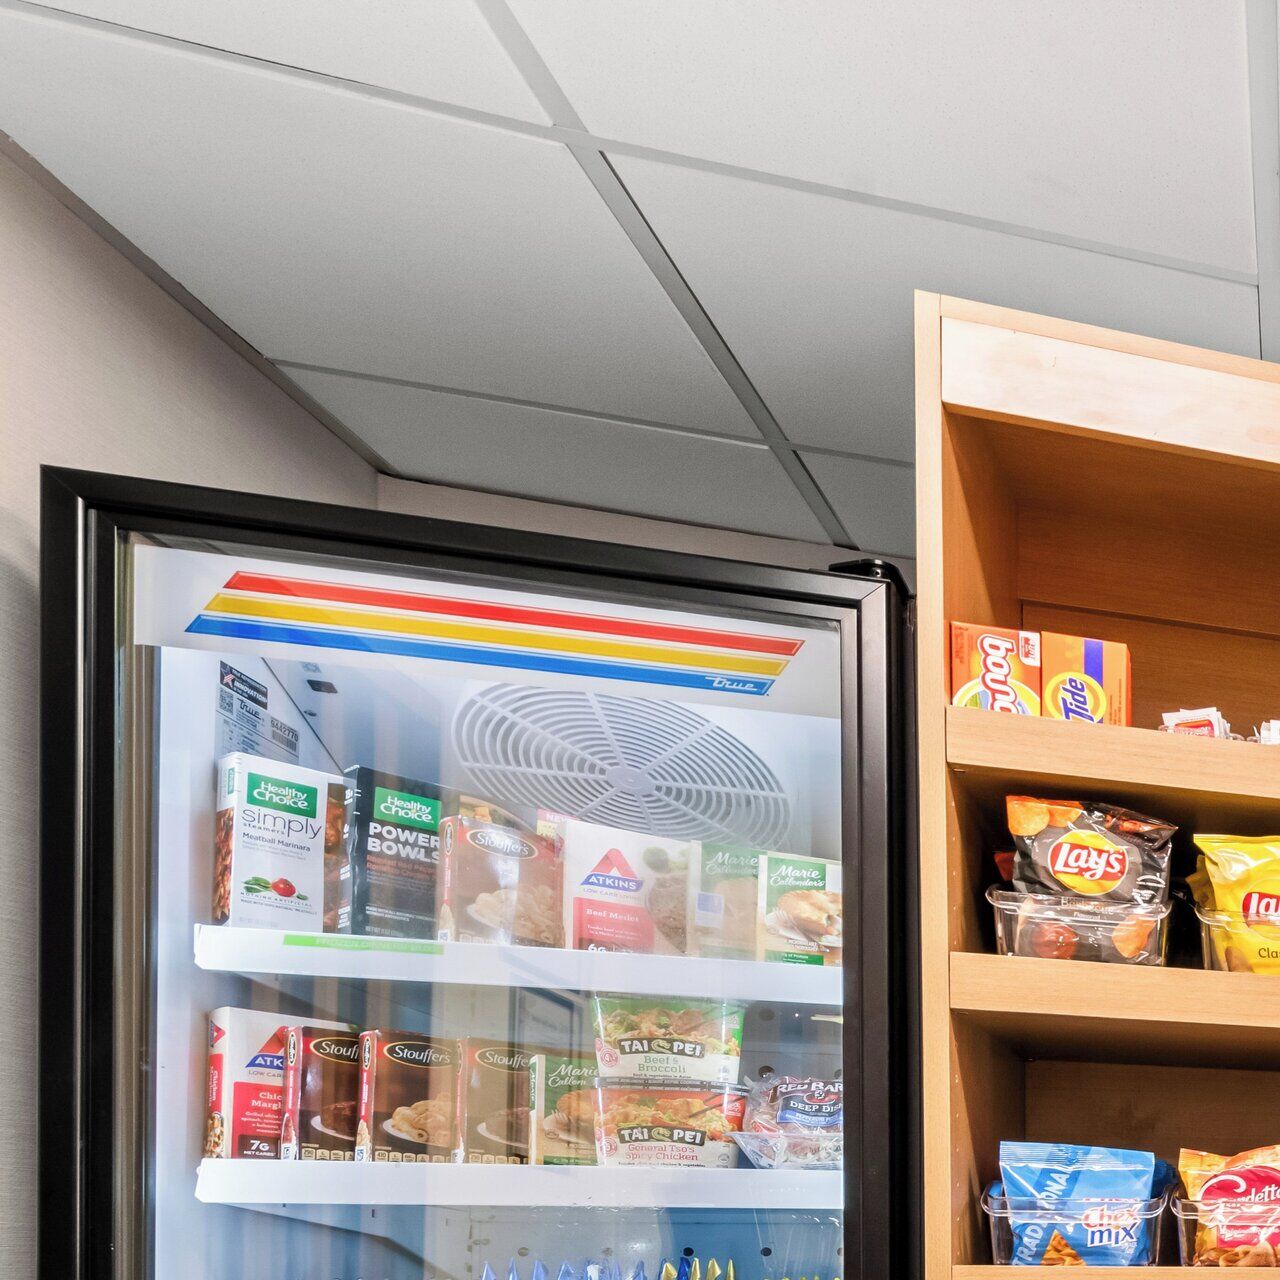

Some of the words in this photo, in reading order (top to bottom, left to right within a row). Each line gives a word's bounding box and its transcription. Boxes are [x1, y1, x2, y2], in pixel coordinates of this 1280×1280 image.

[1061, 677, 1094, 722] Tide
[261, 781, 307, 800] Healthy
[253, 788, 308, 809] Choice
[387, 796, 431, 814] Healthy
[380, 805, 433, 822] Choice
[241, 808, 321, 839] simply
[243, 823, 285, 835] steamers
[242, 833, 275, 845] Meatball
[278, 837, 311, 852] Marinara
[476, 831, 529, 855] Stouffer's
[1054, 843, 1123, 880] Lay's
[771, 865, 821, 878] Marie
[588, 874, 637, 890] ATKINS
[770, 875, 825, 887] Callender's
[586, 908, 608, 917] Beef
[395, 1045, 450, 1063] Stouffer's
[621, 1041, 648, 1053] TAI
[673, 1041, 704, 1056] PEI
[643, 1055, 669, 1066] Beef
[638, 1063, 686, 1075] Broccoli
[778, 1082, 807, 1093] RED
[790, 1100, 820, 1112] DEEP
[620, 1129, 649, 1142] TAI
[673, 1131, 702, 1144] PEI
[250, 1140, 270, 1151] 7G
[628, 1144, 666, 1153] General
[669, 1145, 695, 1153] Tso's
[656, 1152, 698, 1162] Chicken
[1083, 1204, 1141, 1228] Chex
[1088, 1226, 1137, 1247] mix
